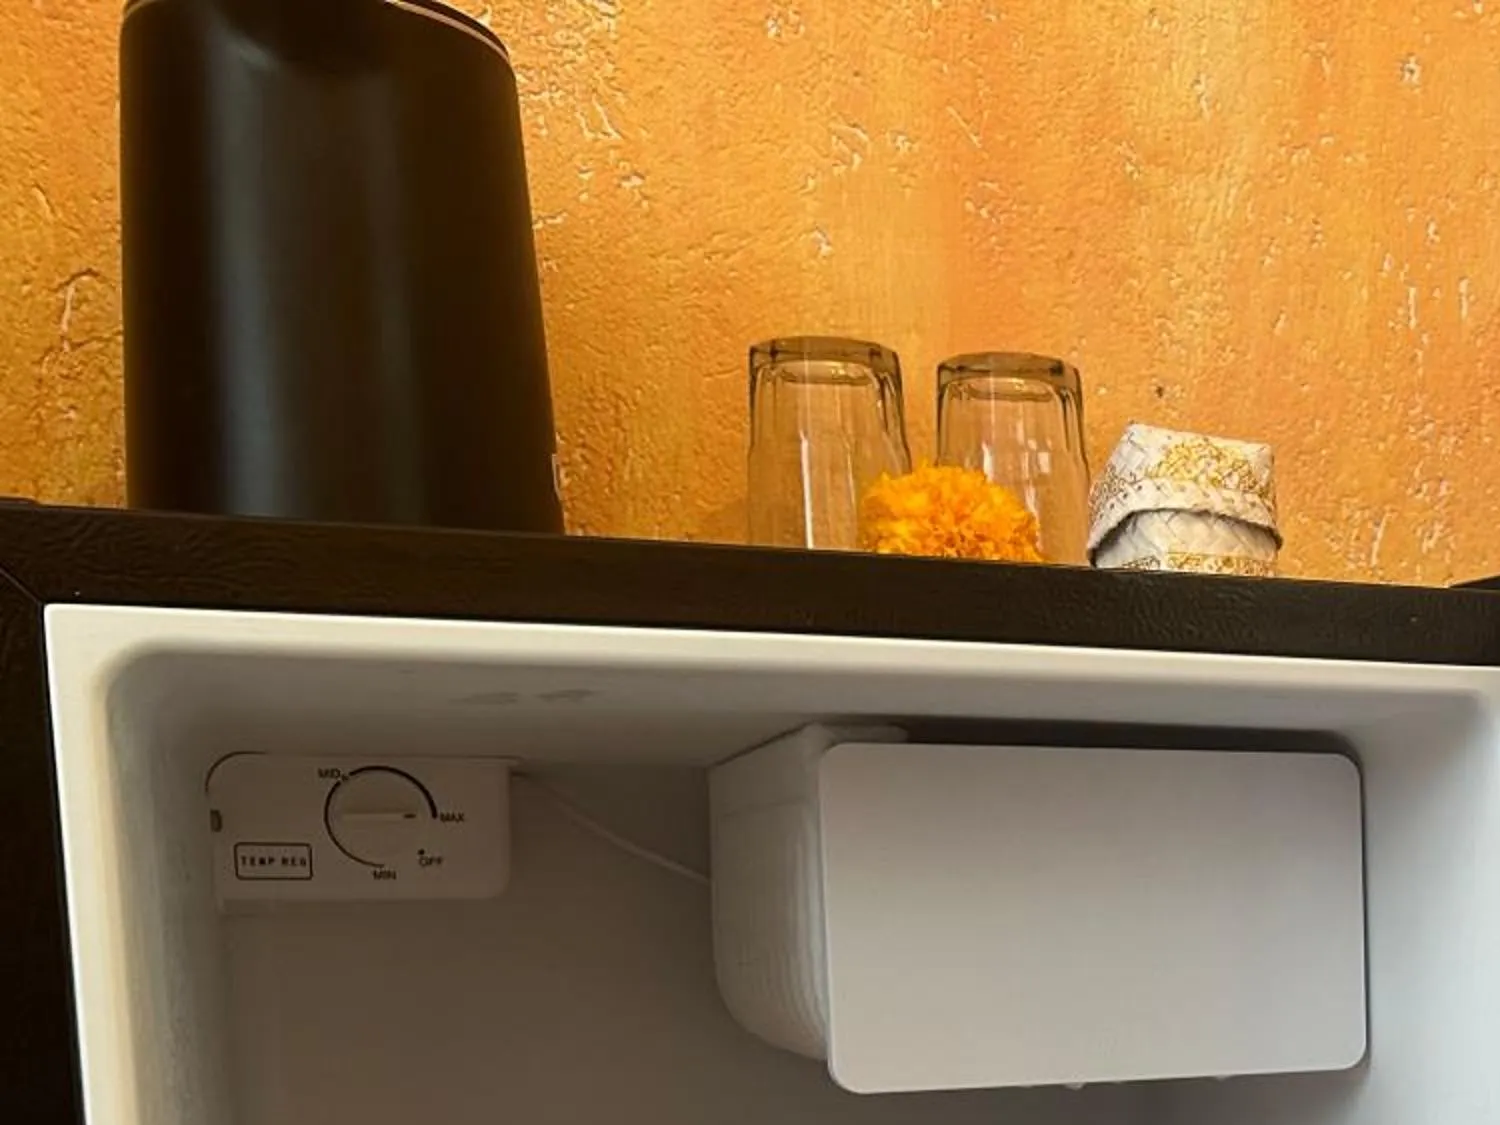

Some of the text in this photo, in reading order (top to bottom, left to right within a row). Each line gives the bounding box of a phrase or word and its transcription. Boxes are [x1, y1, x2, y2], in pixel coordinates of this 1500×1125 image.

[440, 812, 465, 824] MAX
[241, 855, 275, 867] TEMP
[419, 855, 444, 867] OFF
[373, 870, 397, 881] MIN
